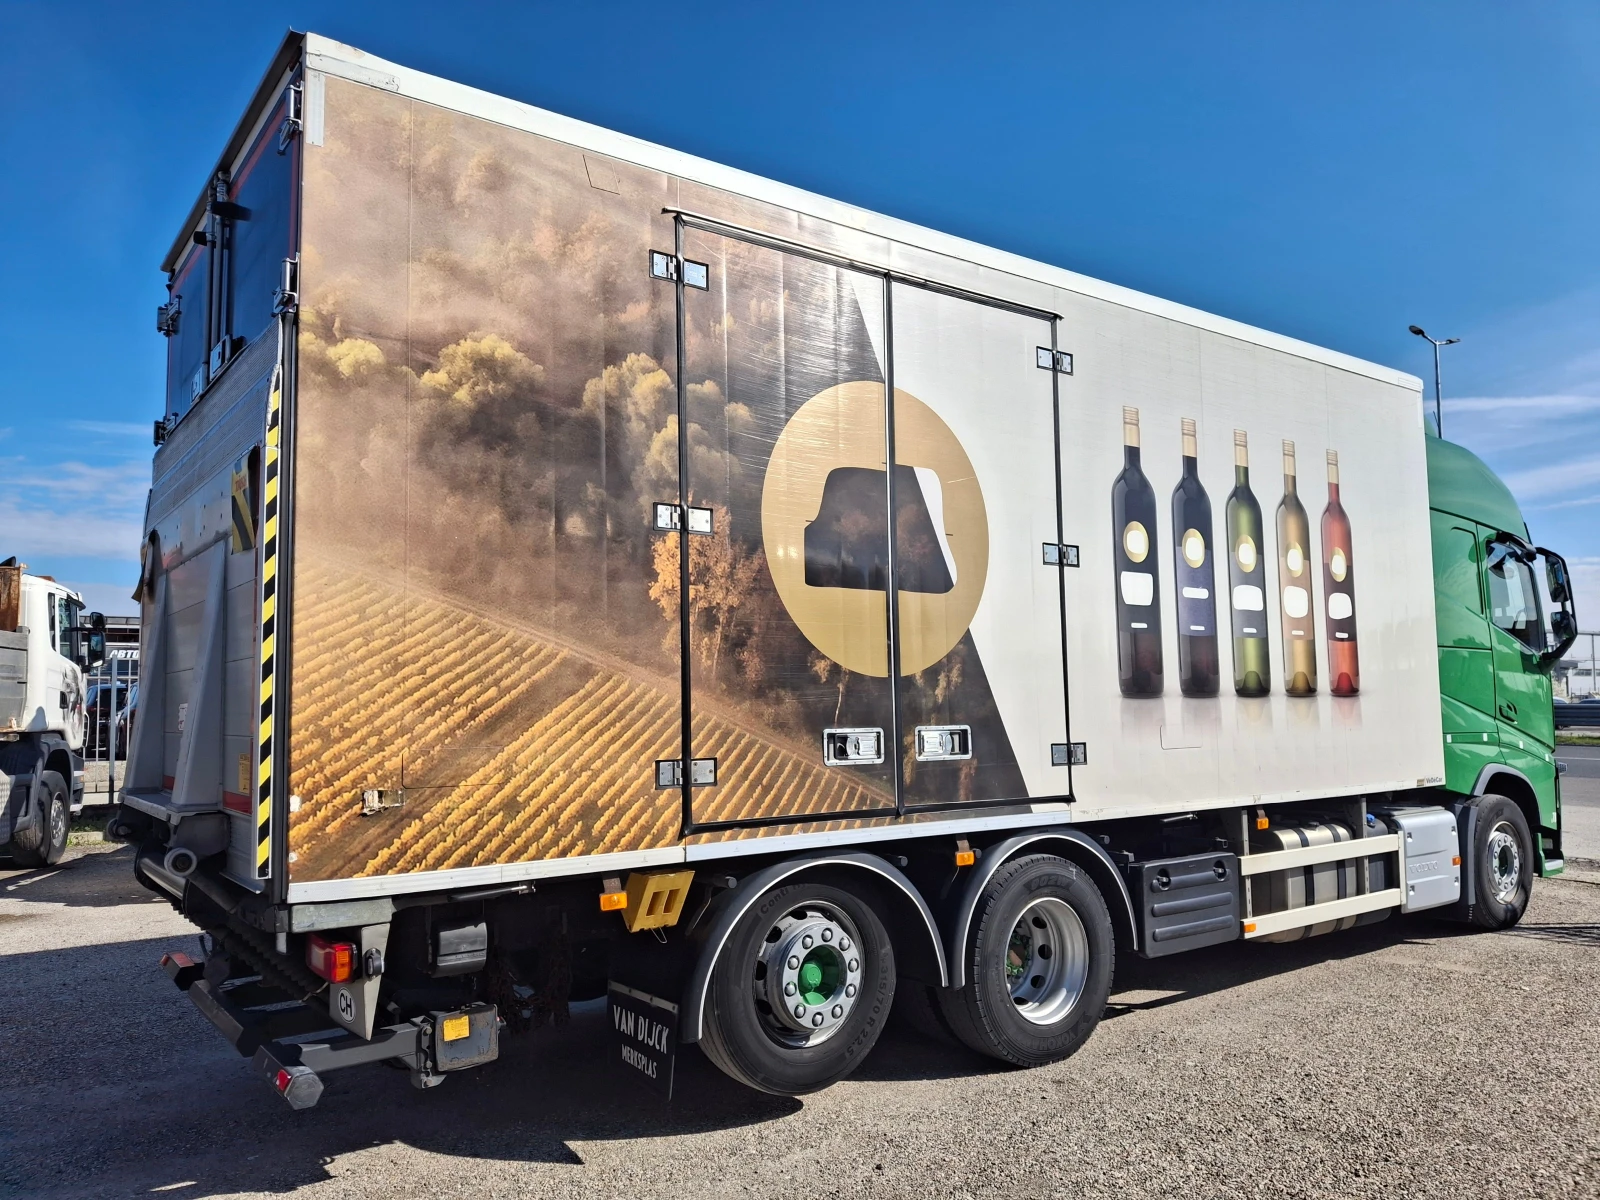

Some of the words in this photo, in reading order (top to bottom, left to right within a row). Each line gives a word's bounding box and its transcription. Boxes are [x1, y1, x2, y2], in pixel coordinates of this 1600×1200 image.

[340, 992, 352, 1017] CH
[613, 1004, 635, 1037] VAN
[637, 1015, 670, 1054] DIJCK
[621, 1043, 658, 1079] MERKSPLAS
